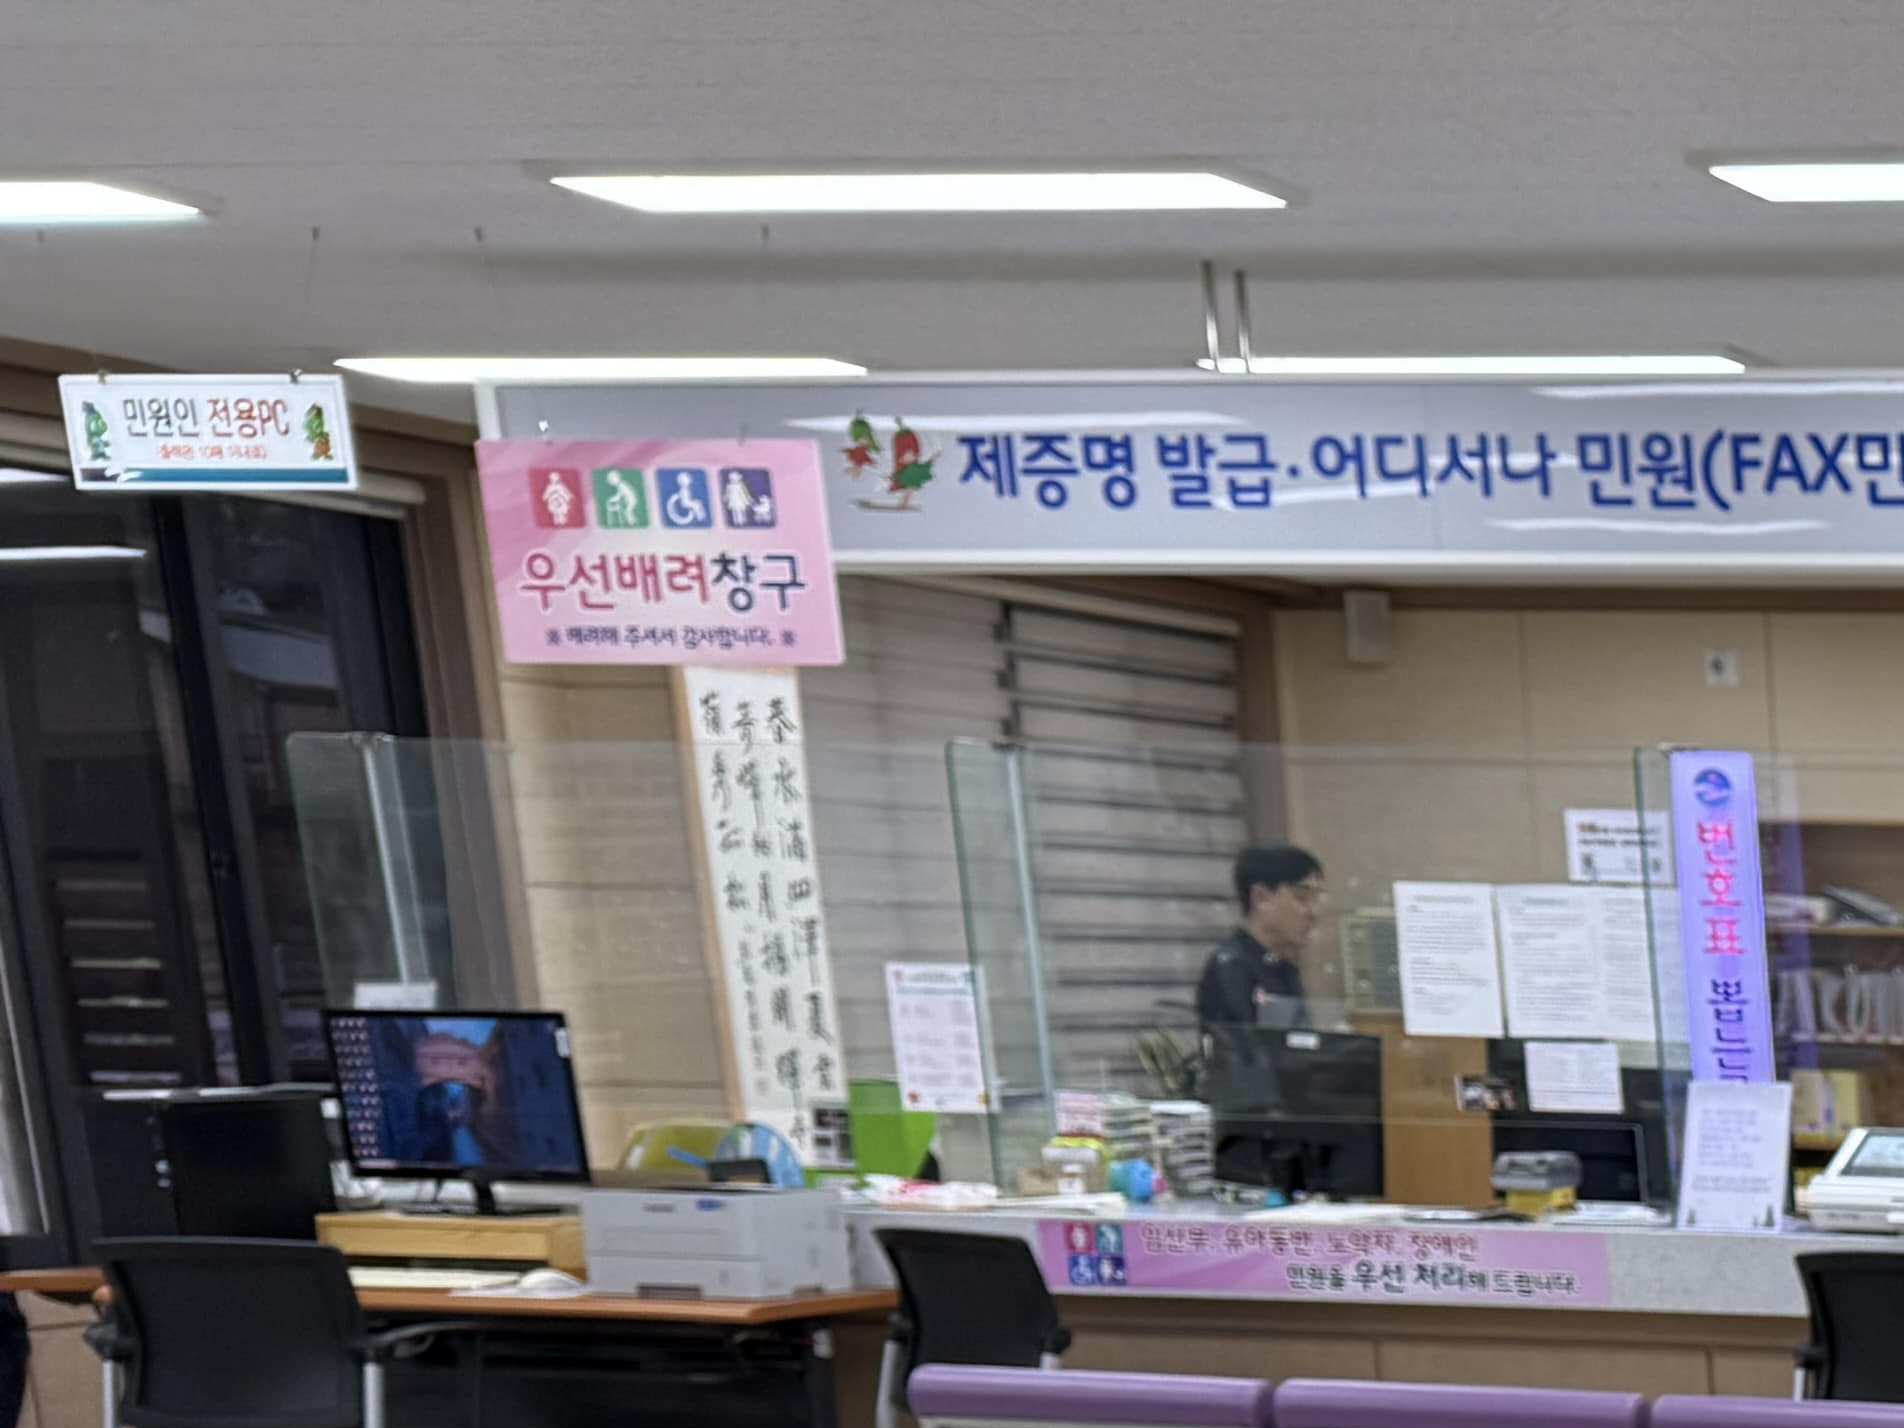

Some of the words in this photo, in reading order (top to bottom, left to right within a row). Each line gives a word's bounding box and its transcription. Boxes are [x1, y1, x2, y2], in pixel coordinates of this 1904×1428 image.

[123, 399, 200, 437] 민원인
[208, 399, 290, 438] 전용PC
[959, 431, 1137, 505] 제증명
[520, 553, 805, 611] 우선배려창구
[567, 625, 619, 645] 배려해
[1351, 1259, 1405, 1293] 우선
